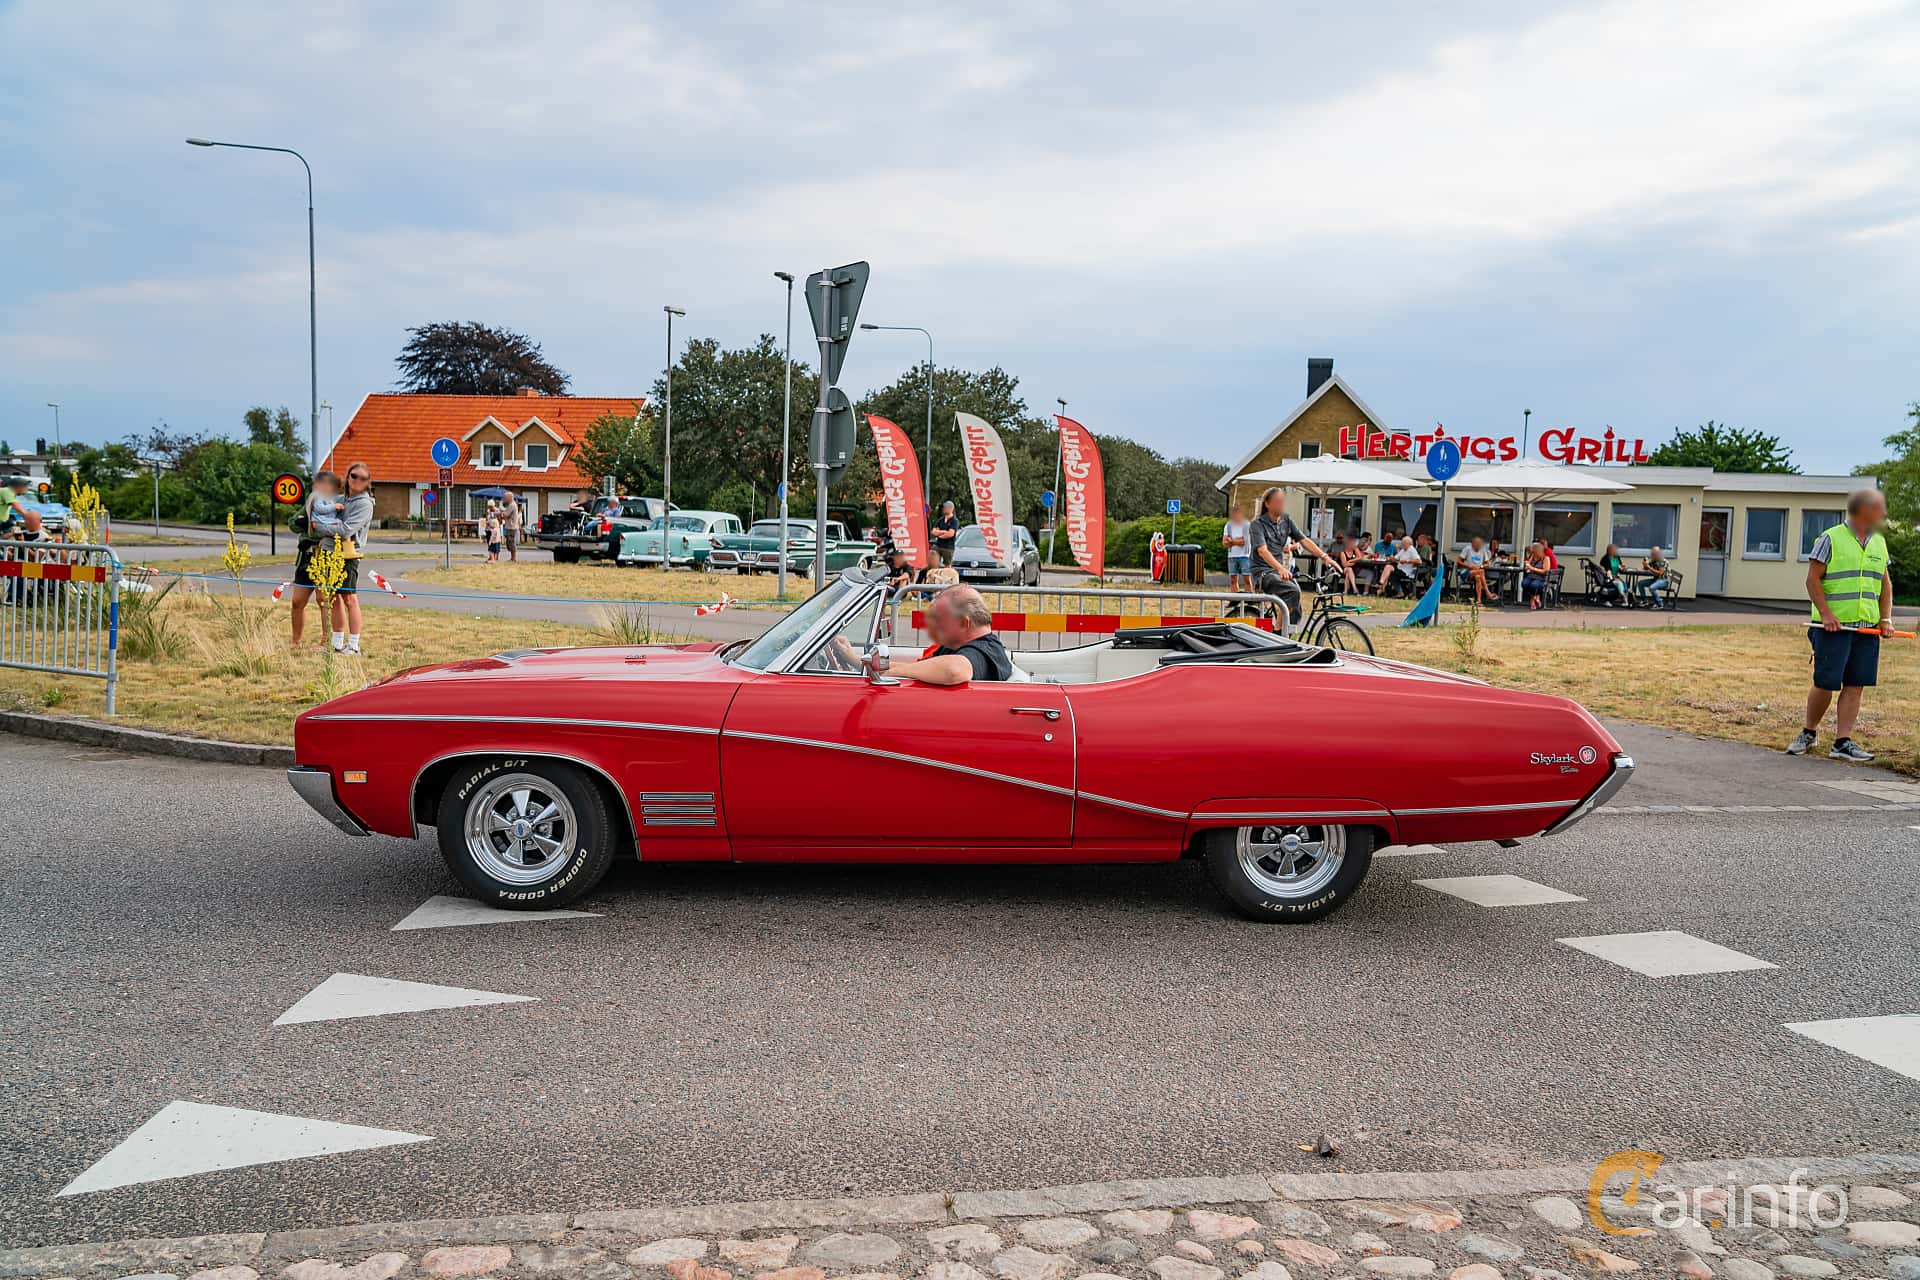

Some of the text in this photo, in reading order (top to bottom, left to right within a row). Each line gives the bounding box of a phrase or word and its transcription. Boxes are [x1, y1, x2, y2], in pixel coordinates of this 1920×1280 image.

[1338, 423, 1650, 465] HERTNGS GRILL
[279, 483, 298, 496] 30
[1530, 752, 1579, 766] Skylark
[458, 759, 529, 800] RADIAL G/T
[499, 848, 588, 900] COOPER COBRA
[1260, 889, 1336, 913] RADIAL G/T
